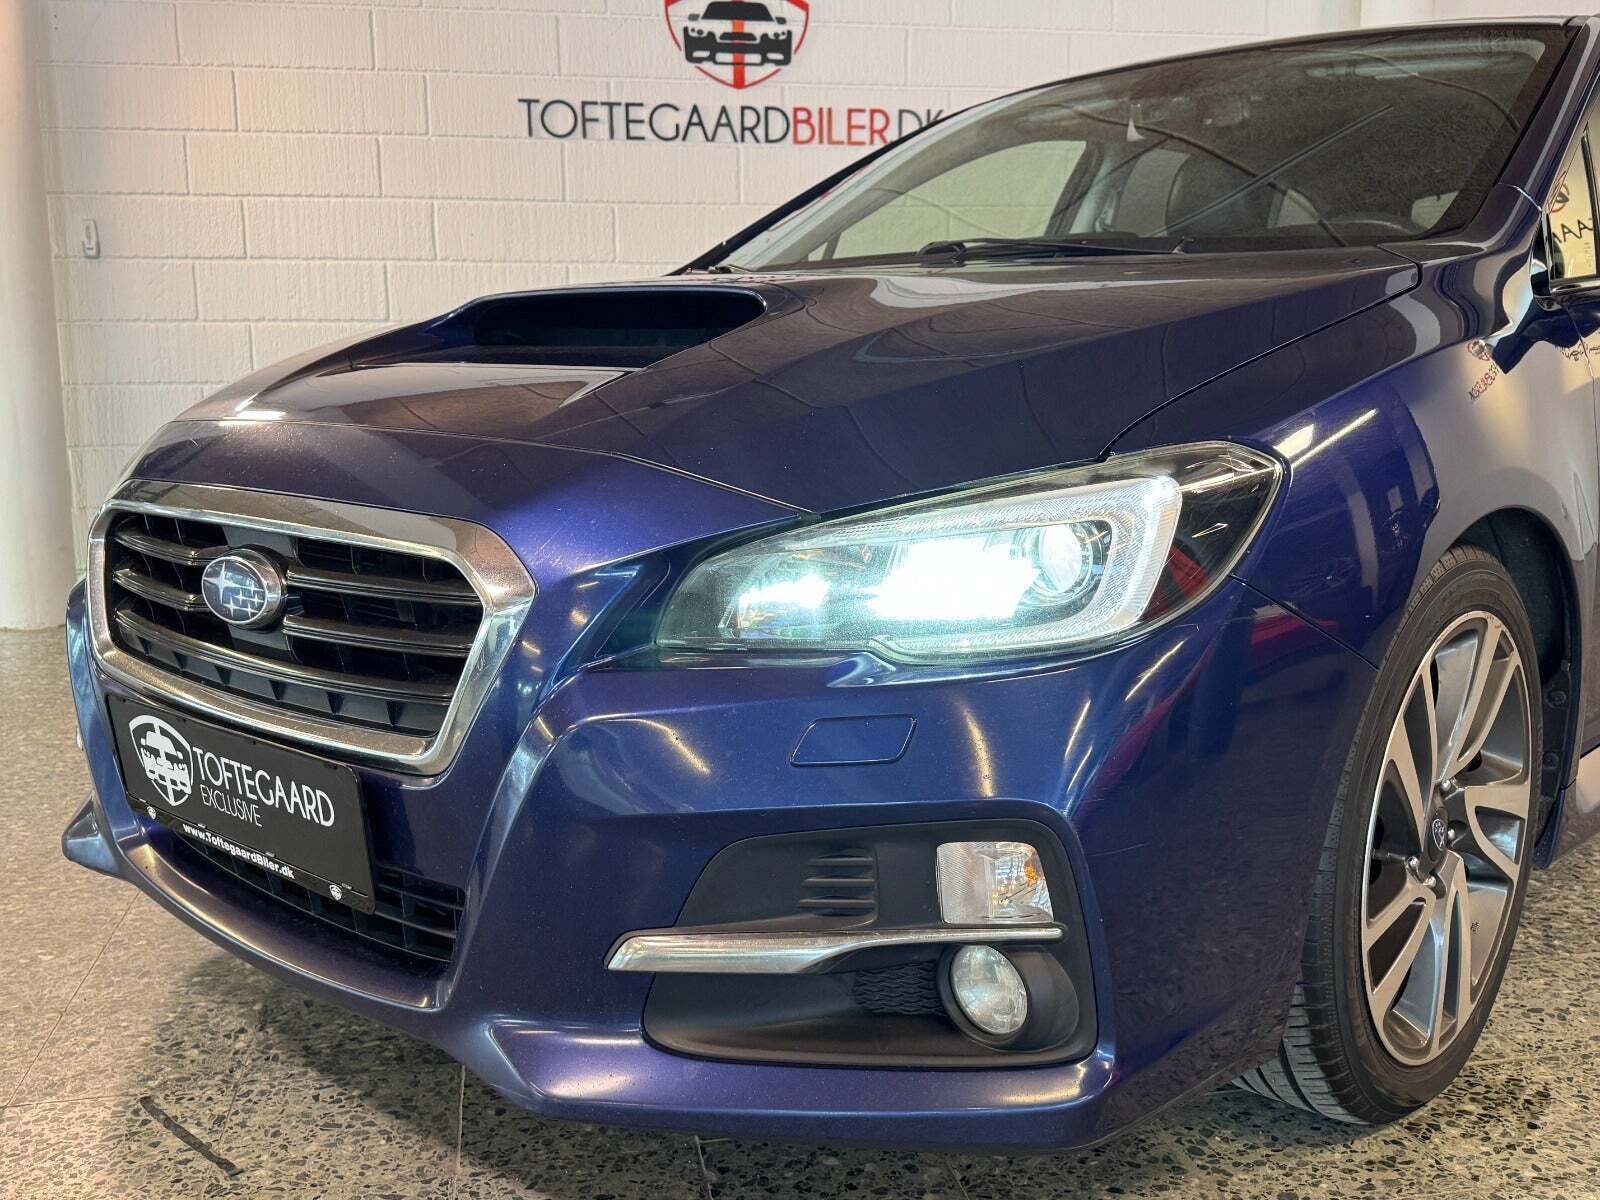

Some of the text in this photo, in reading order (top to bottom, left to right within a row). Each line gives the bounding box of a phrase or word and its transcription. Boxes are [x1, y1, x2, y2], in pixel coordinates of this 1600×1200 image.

[192, 746, 335, 827] TOFTEGAARD
[200, 784, 262, 827] EXCLUSIVE
[182, 823, 295, 879] www.ToftegaardBiler.dk
